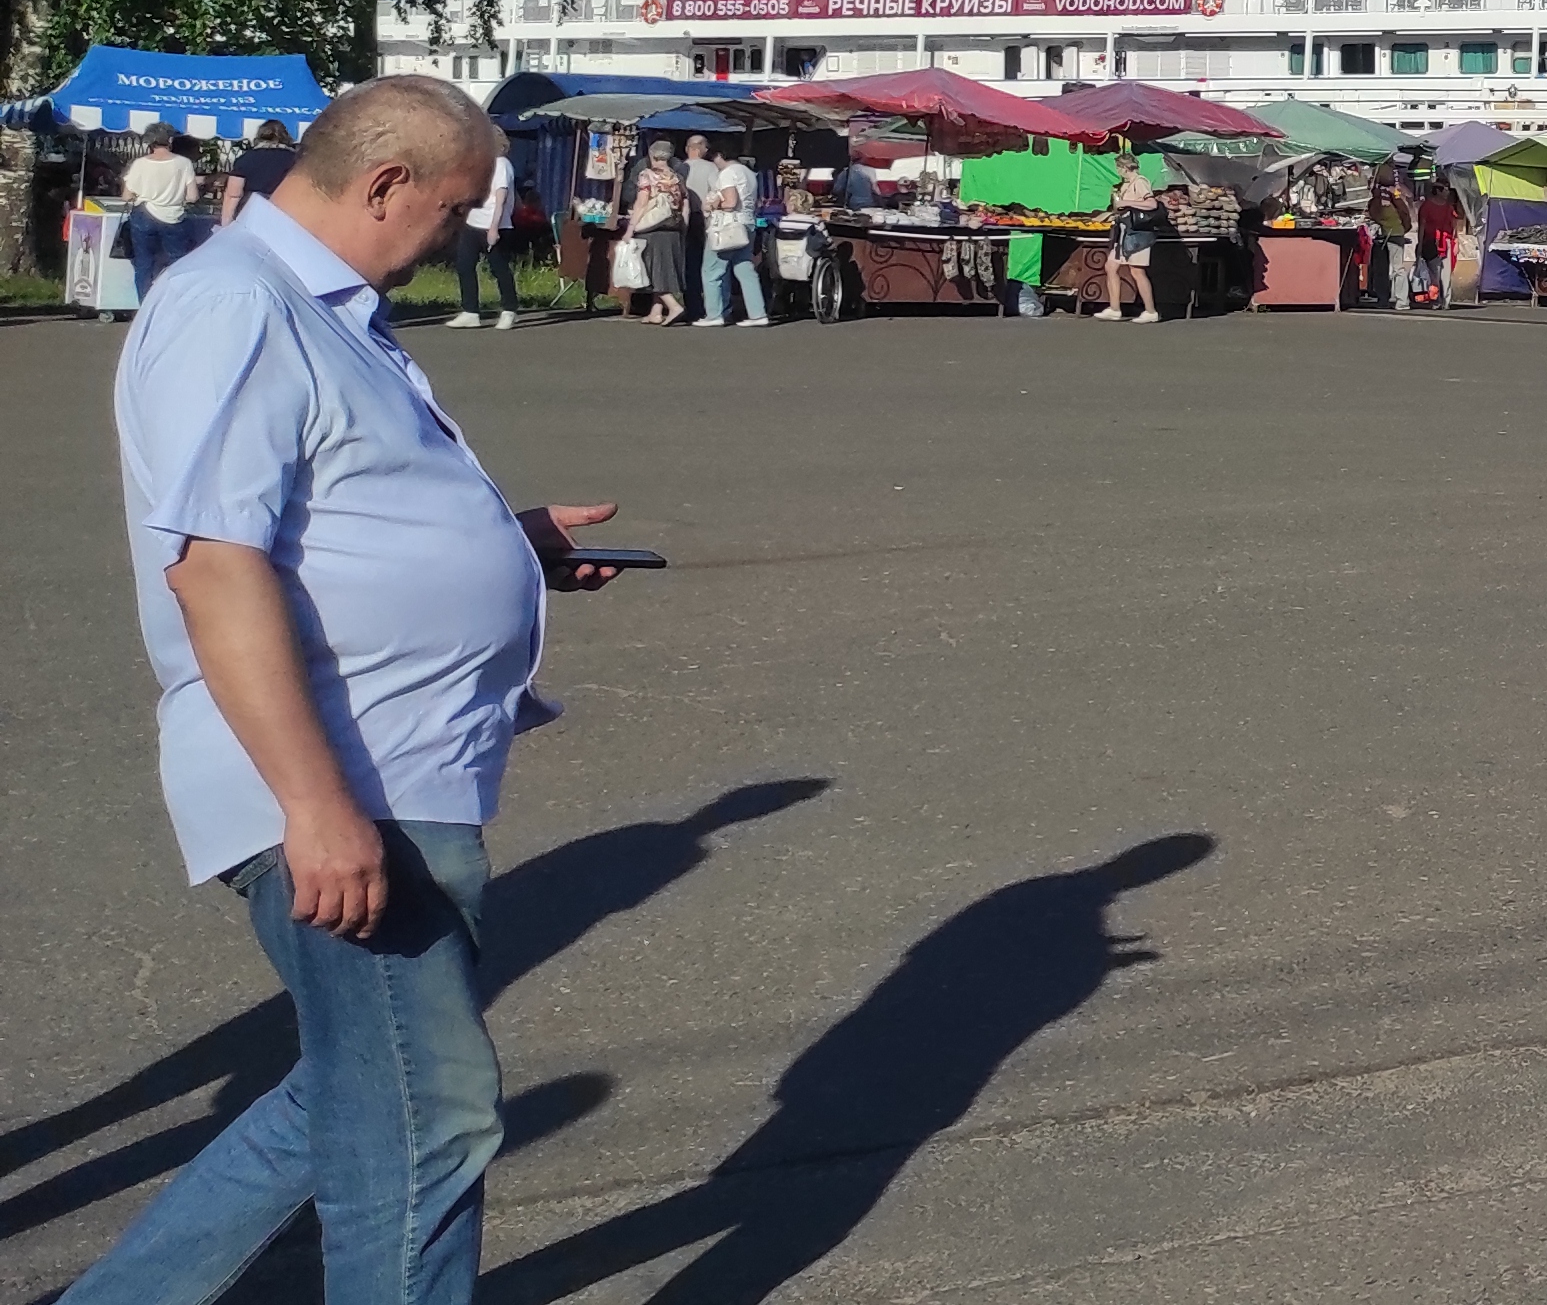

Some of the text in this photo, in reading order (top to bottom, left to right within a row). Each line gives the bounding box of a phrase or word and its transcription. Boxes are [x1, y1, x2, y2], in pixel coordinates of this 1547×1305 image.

[672, 1, 682, 16] 8
[684, 1, 714, 16] 800
[716, 0, 790, 16] 555-0505
[117, 72, 284, 92] МОРОЖЕНОЕ
